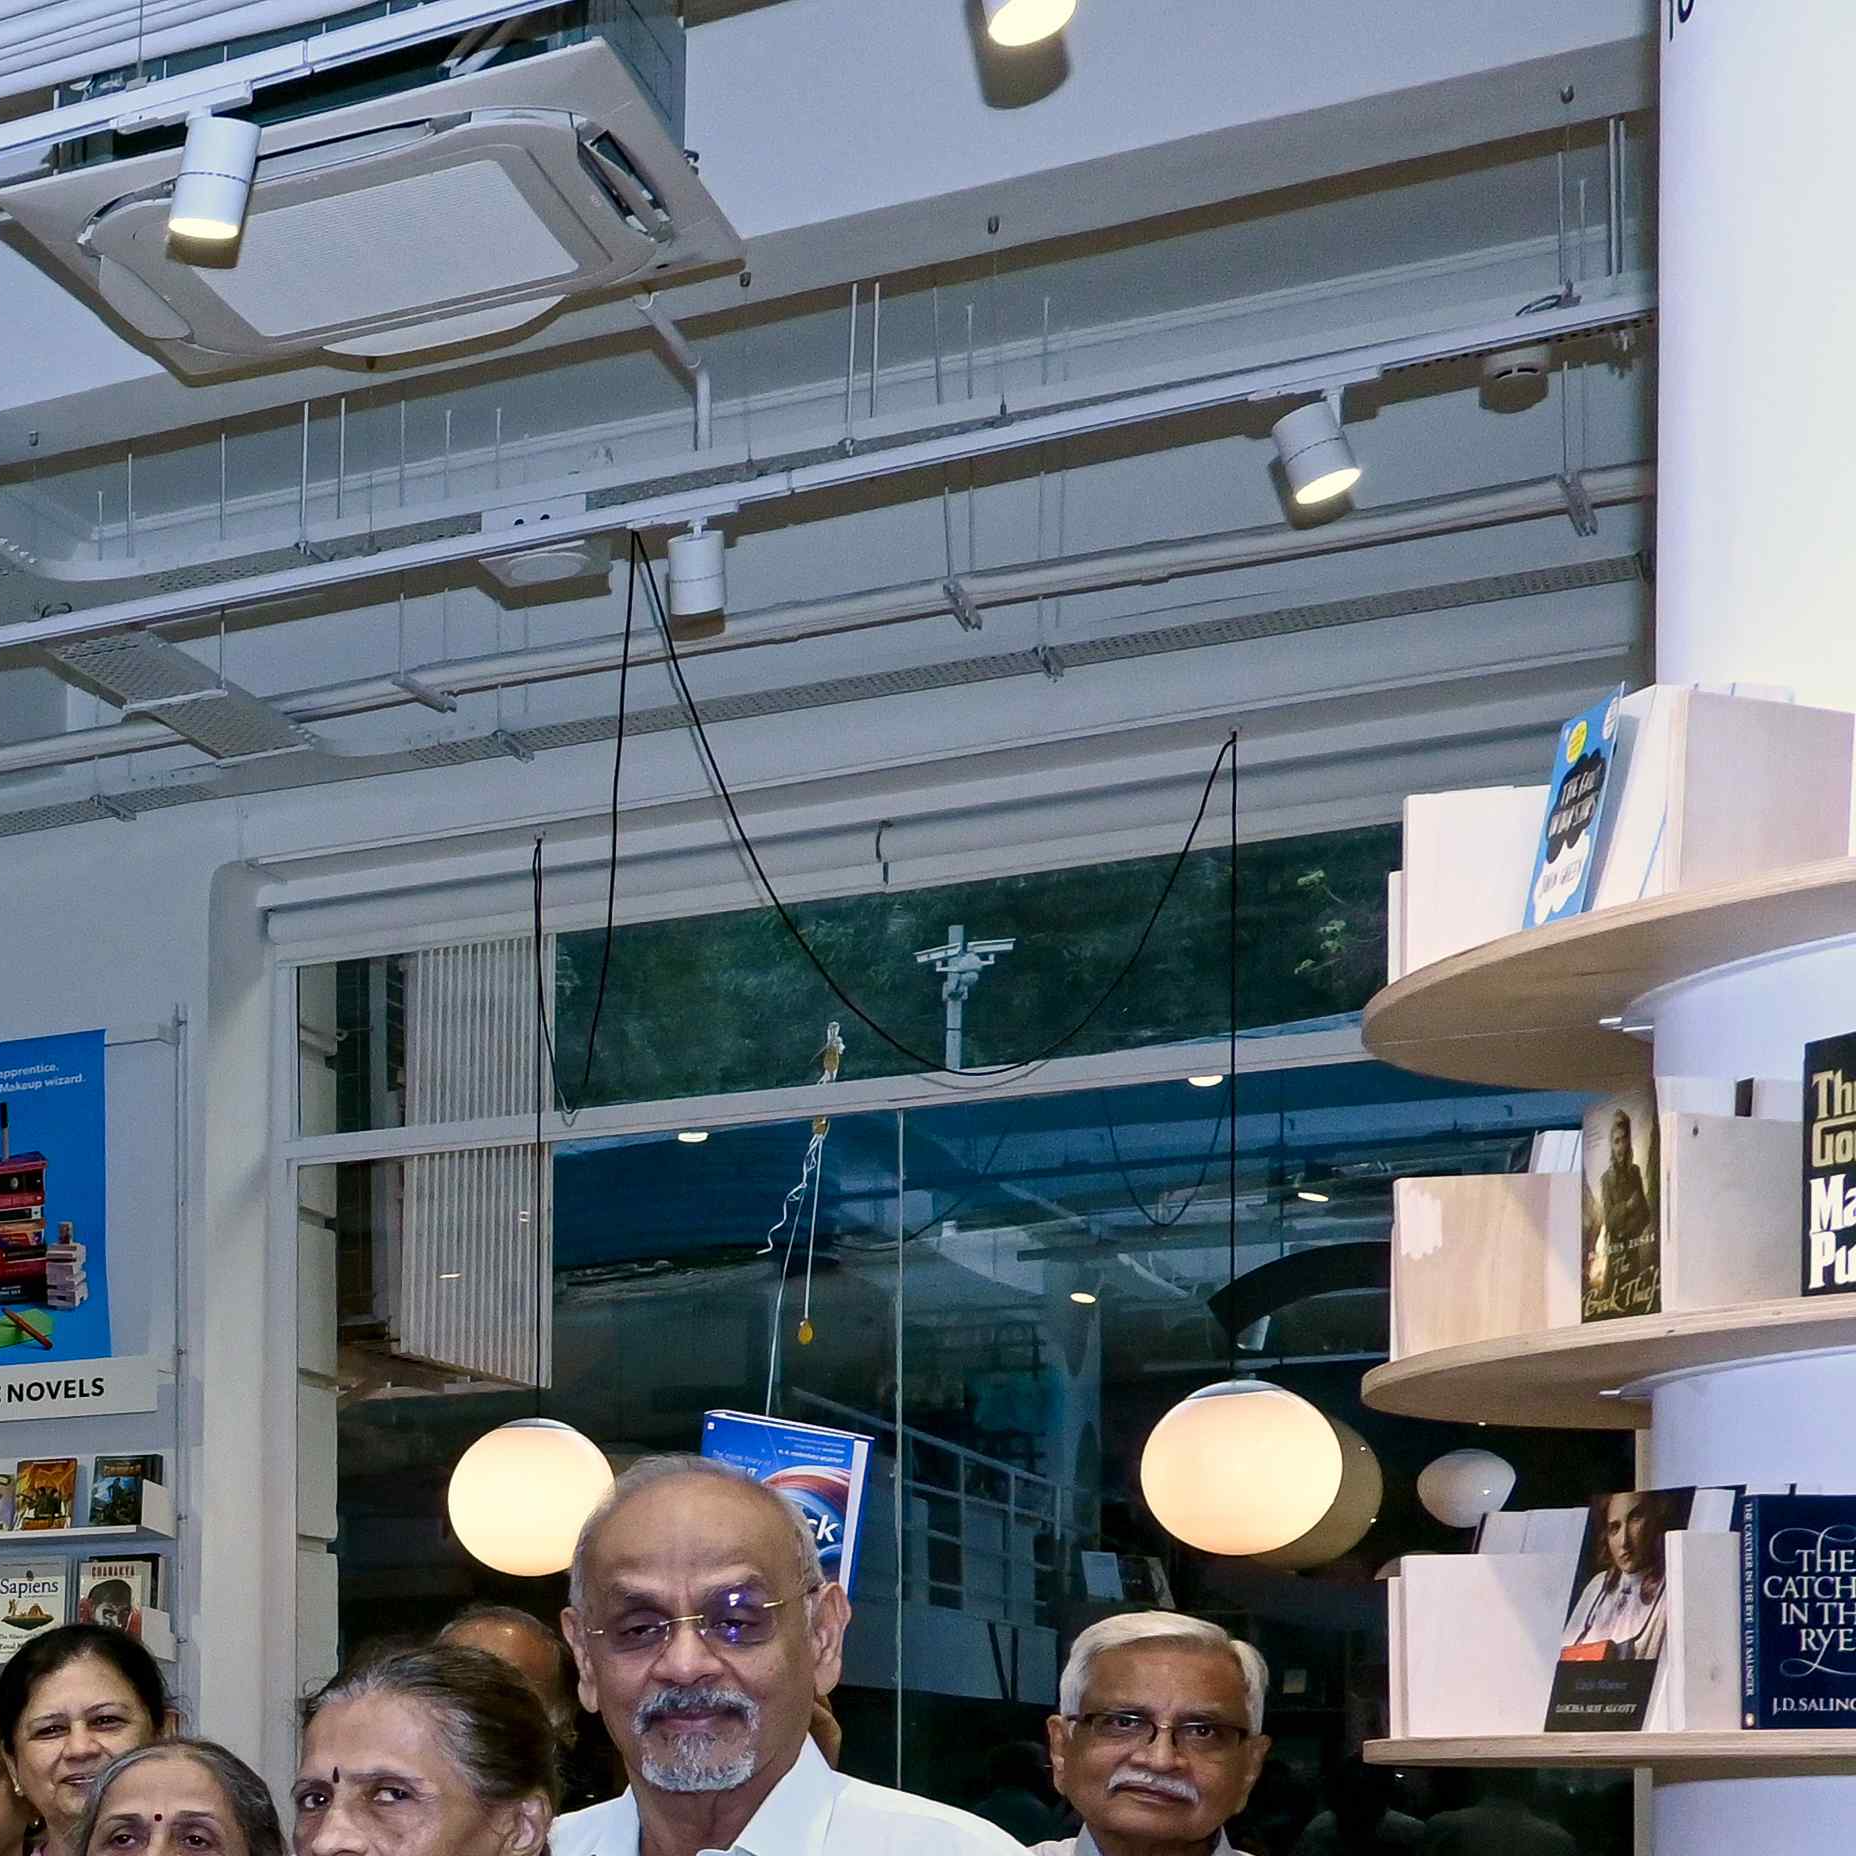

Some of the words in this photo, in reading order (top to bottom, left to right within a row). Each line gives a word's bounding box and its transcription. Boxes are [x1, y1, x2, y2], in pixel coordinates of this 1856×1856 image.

[0, 1080, 43, 1094] Makeup
[44, 1073, 87, 1088] wizard.
[1811, 1068, 1856, 1119] Th
[1808, 1230, 1856, 1289] Pu
[7, 1377, 106, 1403] NOVELS
[1795, 1547, 1855, 1574] THE
[0, 1578, 59, 1597] Sapiens
[1763, 1575, 1856, 1600] CATCH
[1781, 1601, 1809, 1626] IN
[1816, 1601, 1856, 1626] TH
[1800, 1628, 1854, 1656] RYE
